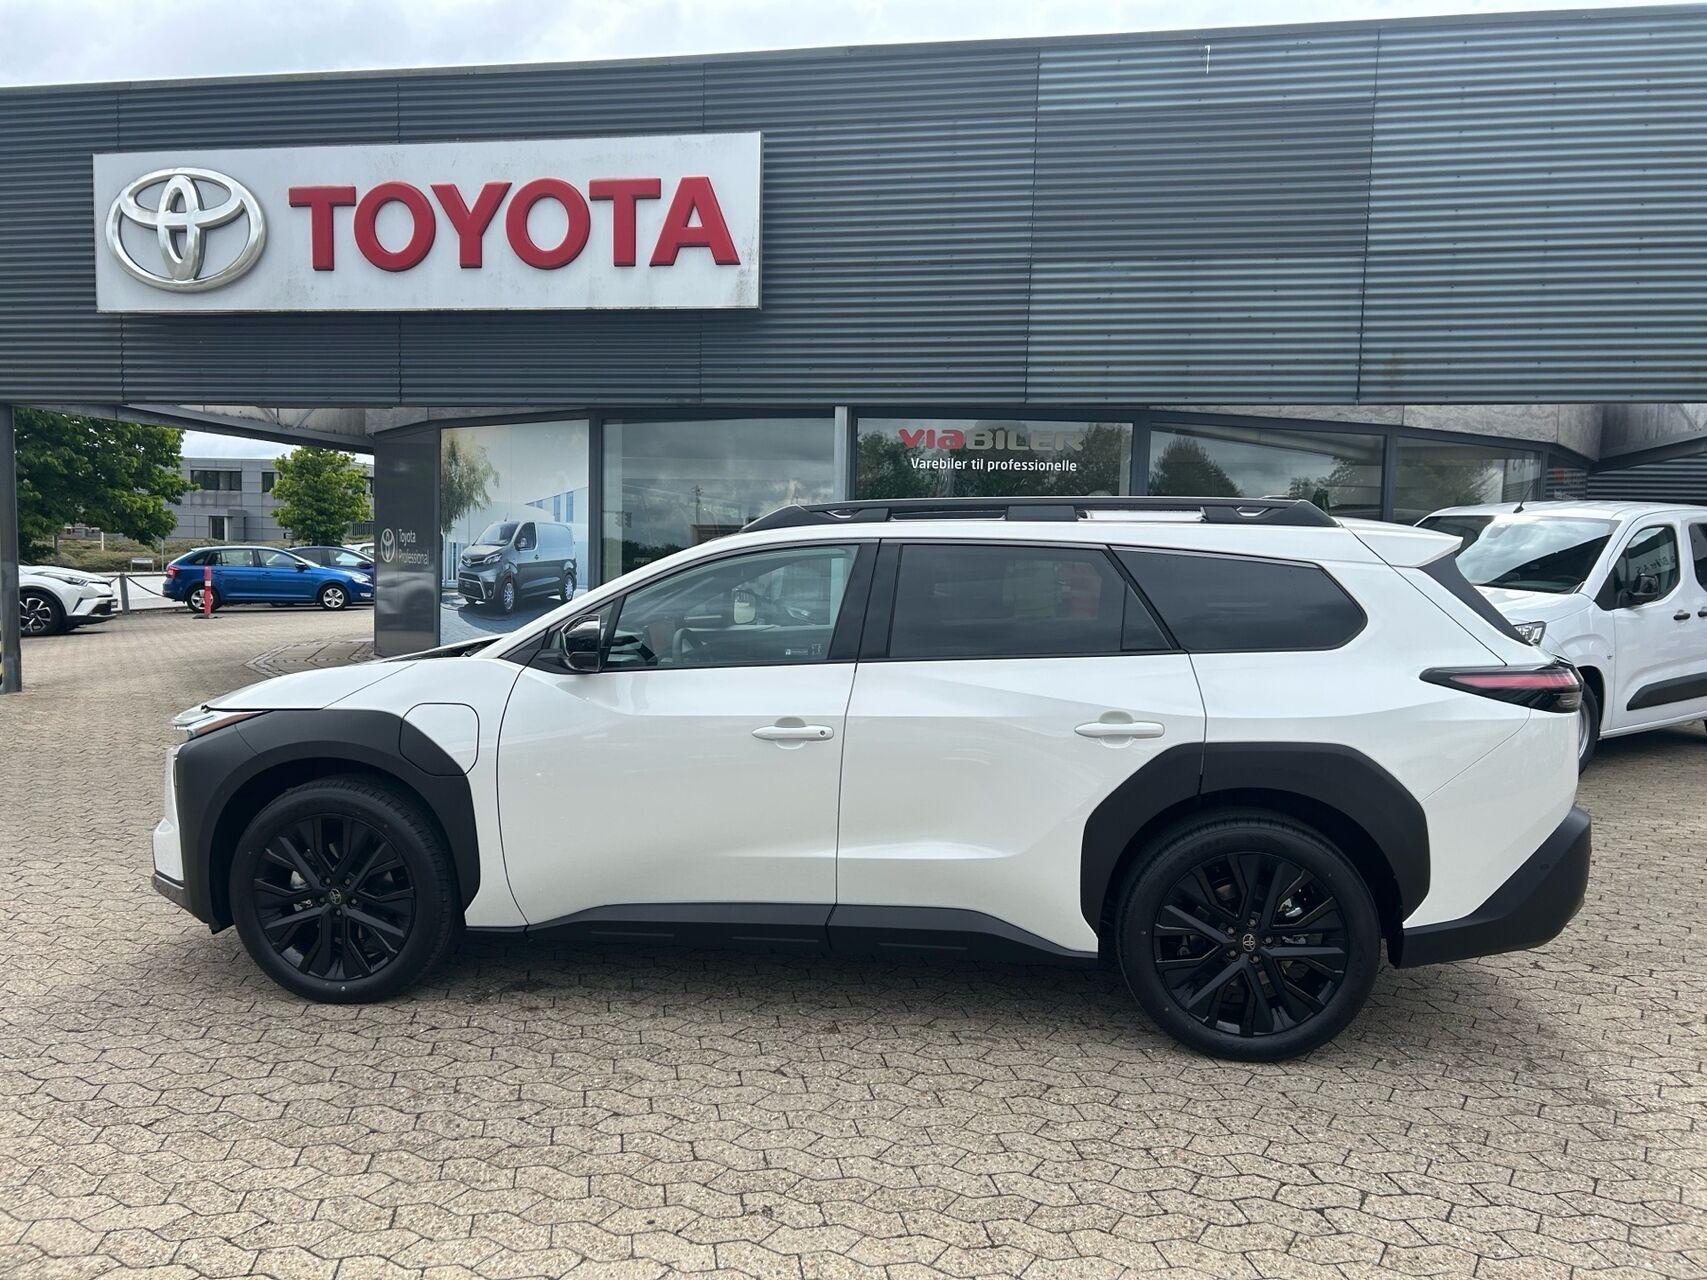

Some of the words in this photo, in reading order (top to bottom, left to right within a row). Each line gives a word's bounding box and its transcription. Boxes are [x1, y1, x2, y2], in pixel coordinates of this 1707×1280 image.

[289, 176, 741, 272] TOYOTA
[911, 457, 967, 470] Varebiler
[971, 458, 984, 470] til
[987, 459, 1077, 472] professionelle
[398, 529, 416, 547] Toyota
[399, 549, 429, 565] Professional
